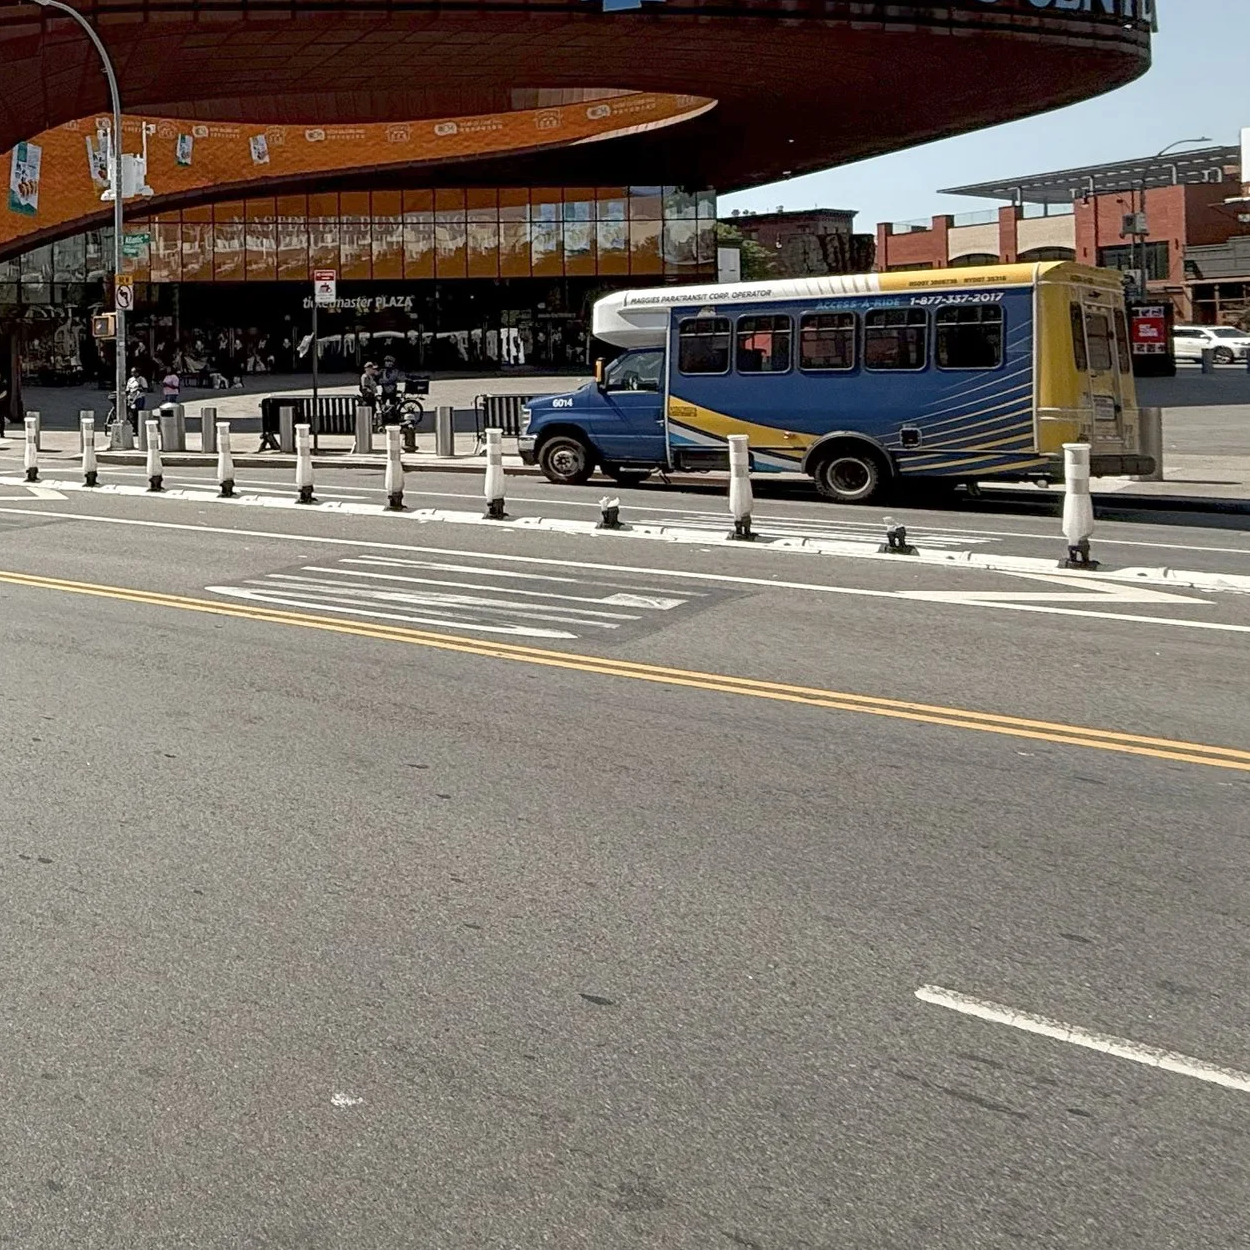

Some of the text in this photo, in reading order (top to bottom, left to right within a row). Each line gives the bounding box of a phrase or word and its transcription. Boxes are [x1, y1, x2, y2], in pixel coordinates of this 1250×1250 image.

[375, 295, 413, 307] PLAZA
[630, 289, 772, 305] MAGGIES PARATRANSIT CORP. OPERATOR
[816, 298, 901, 310] ACCESS-A-RIDE
[552, 398, 573, 408] 6014
